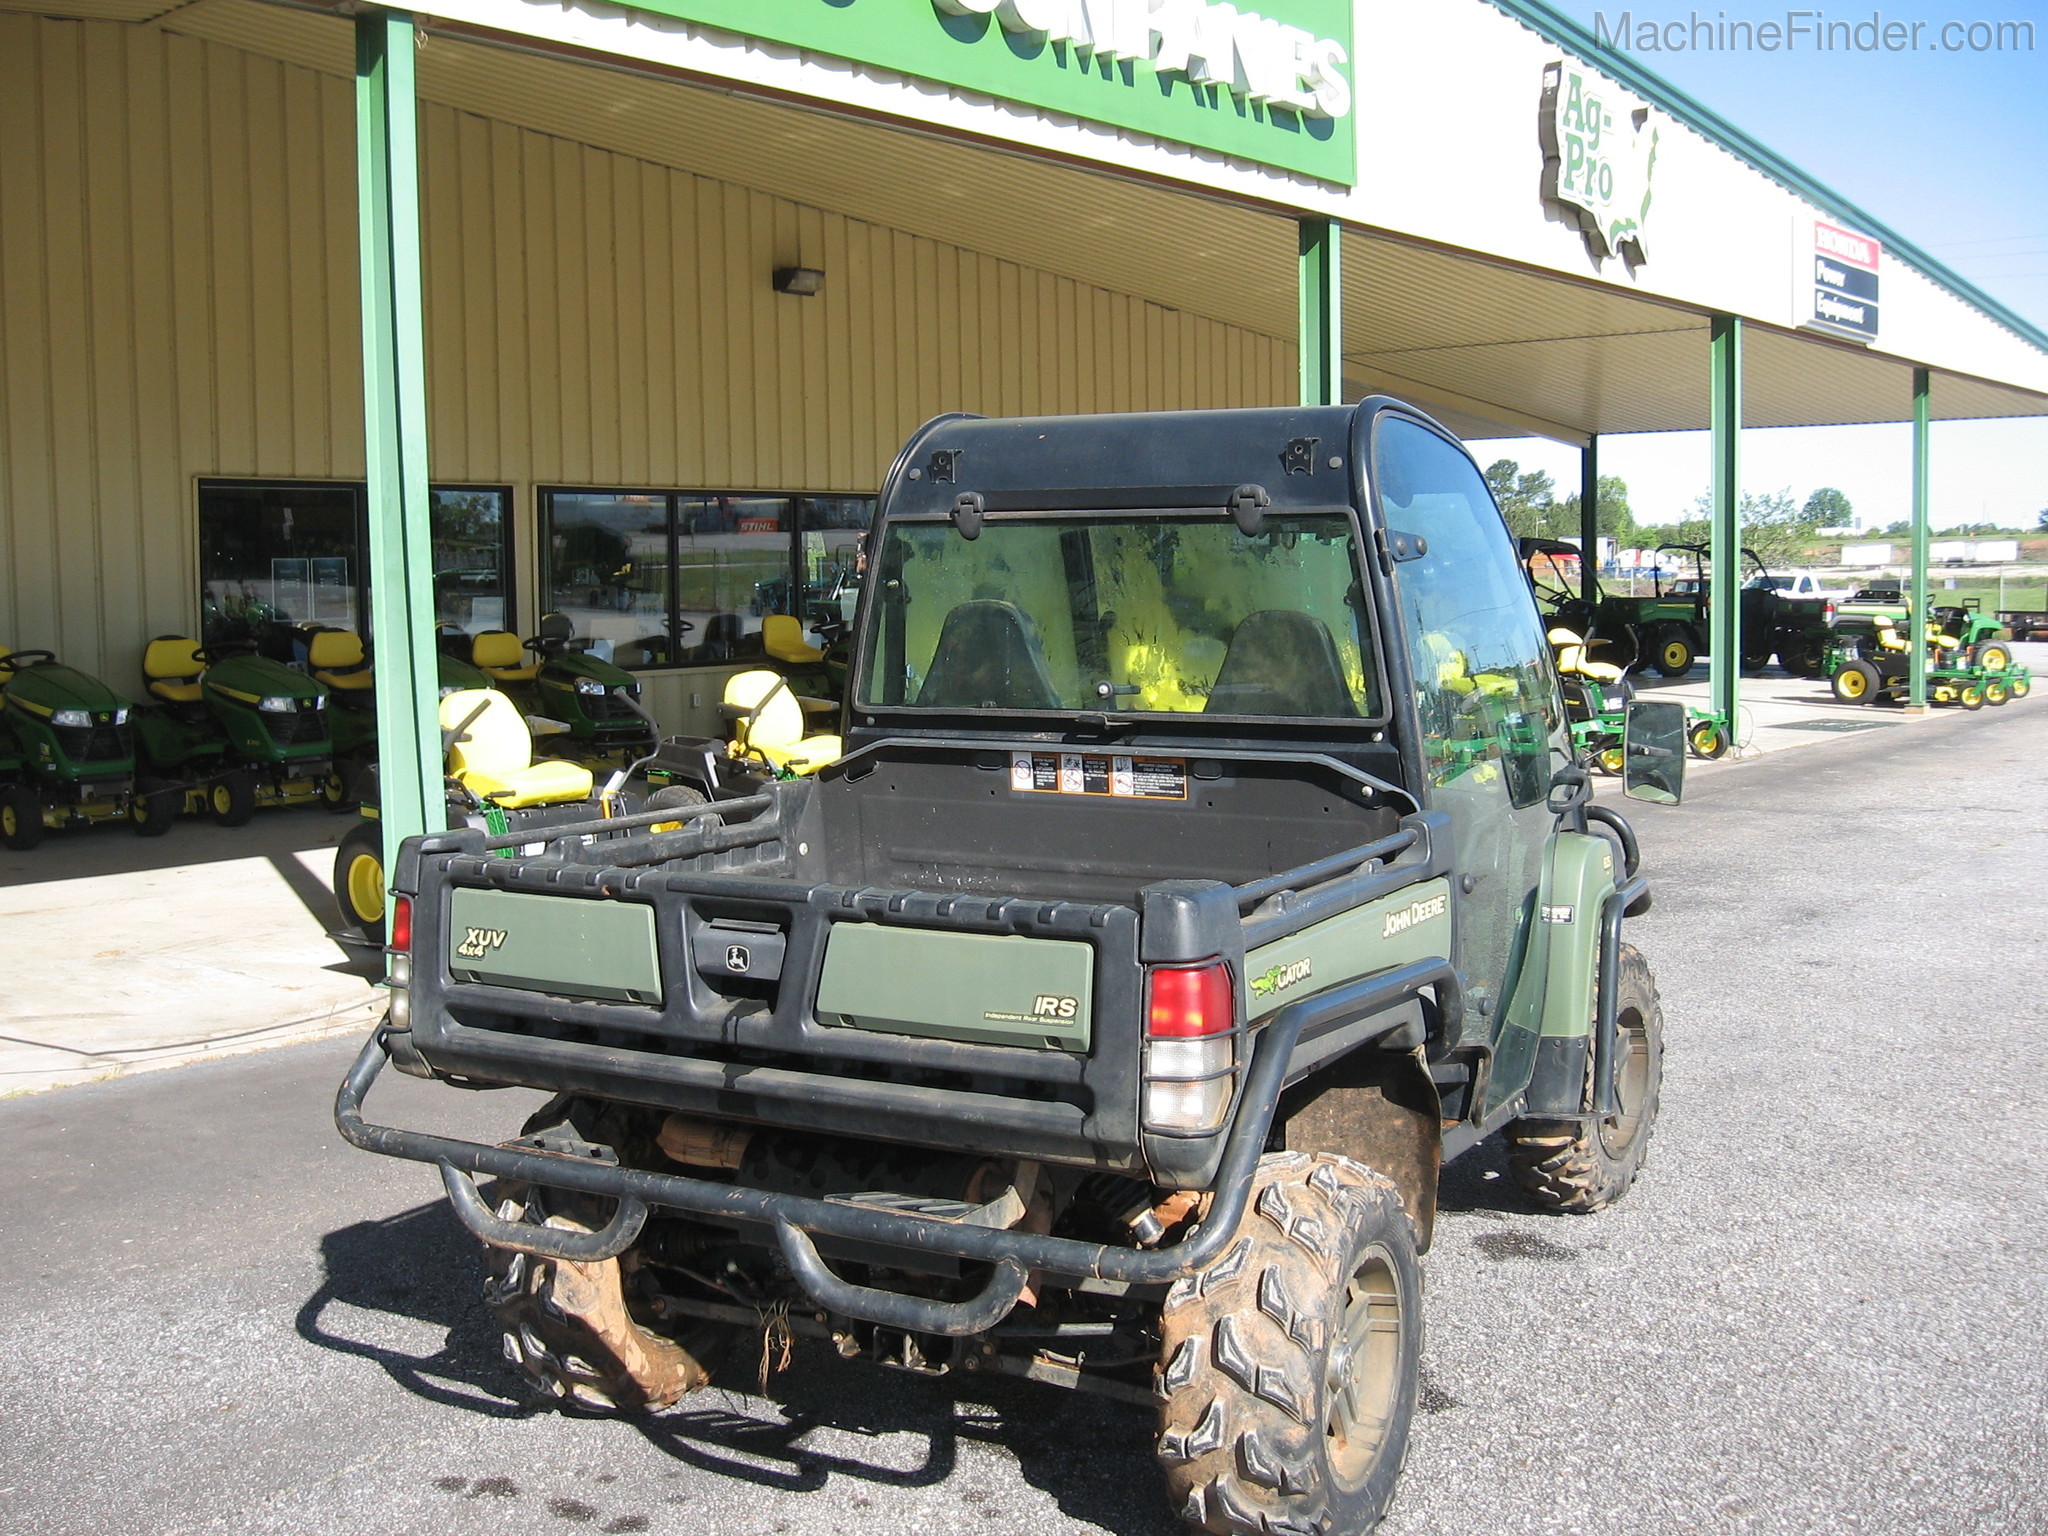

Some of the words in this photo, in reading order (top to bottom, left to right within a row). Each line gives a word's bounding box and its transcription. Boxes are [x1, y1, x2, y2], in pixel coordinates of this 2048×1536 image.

[1562, 72, 1613, 151] Ag-
[1563, 131, 1613, 202] Pro
[1816, 226, 1871, 265] HONDA
[741, 521, 775, 532] STIHL
[1383, 907, 1411, 938] JOHN
[1411, 894, 1447, 925] DEERE
[458, 943, 484, 957] 4x4
[465, 928, 506, 948] XUV
[1277, 957, 1311, 989] GATOR
[1033, 995, 1077, 1018] IRS
